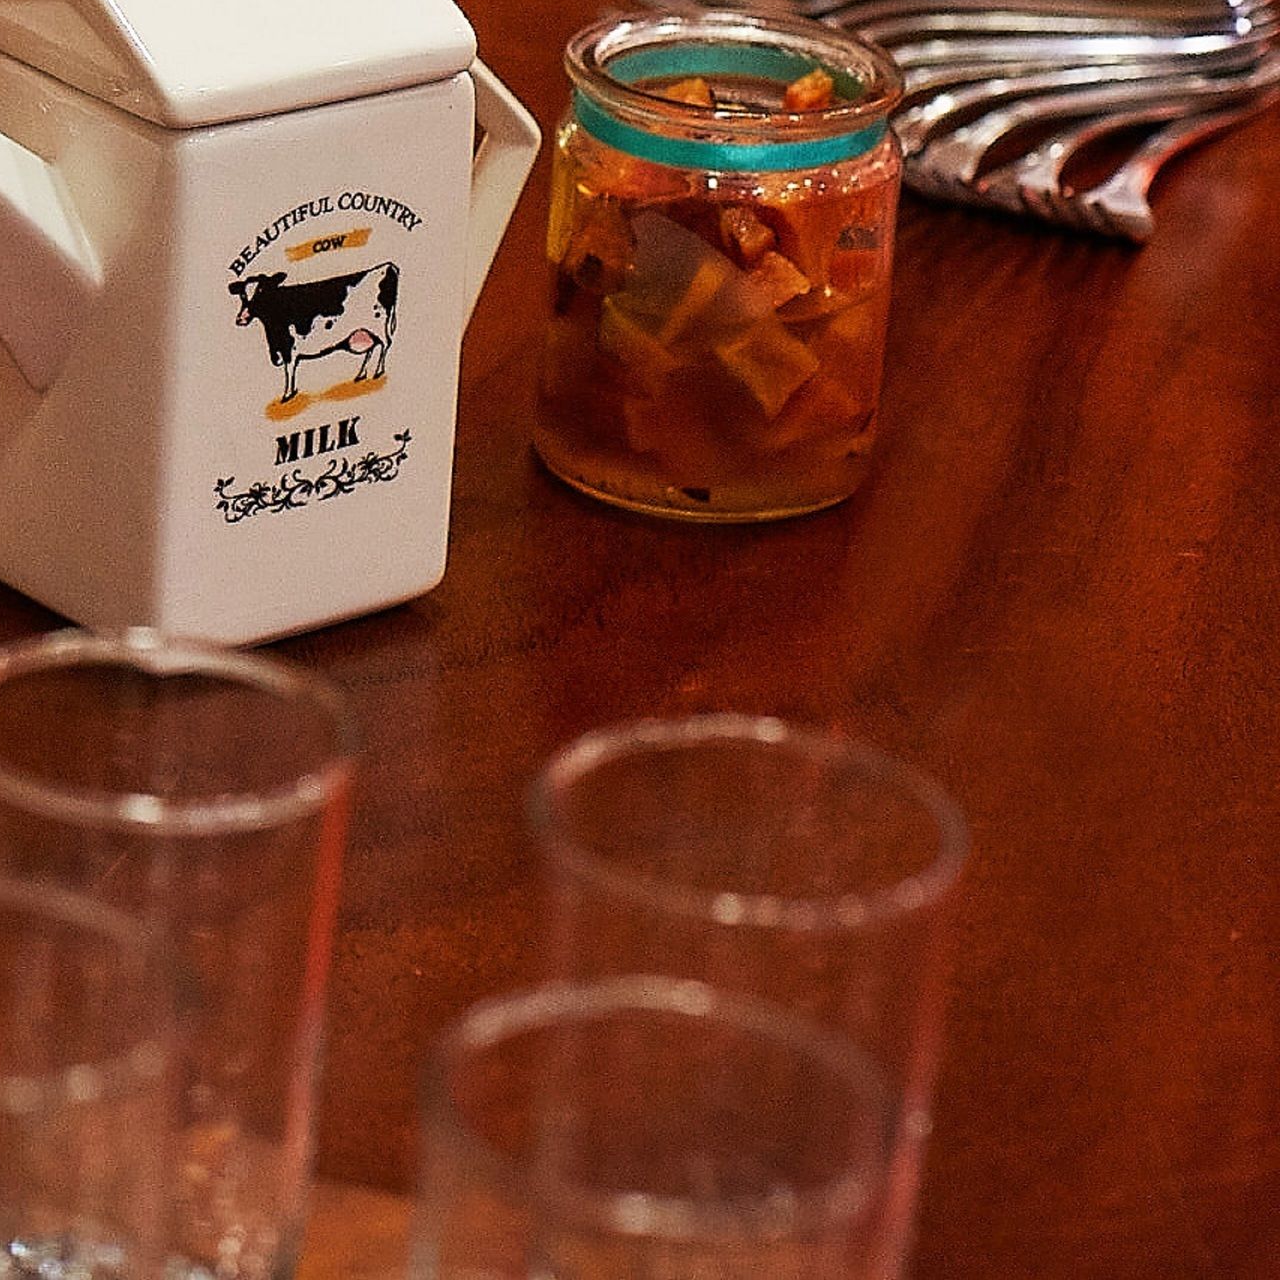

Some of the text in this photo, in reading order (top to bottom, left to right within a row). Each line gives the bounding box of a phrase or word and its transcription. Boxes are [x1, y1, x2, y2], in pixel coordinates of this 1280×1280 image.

[229, 192, 422, 277] BEAUTIFUL COUNTRY
[274, 417, 360, 465] MILK
